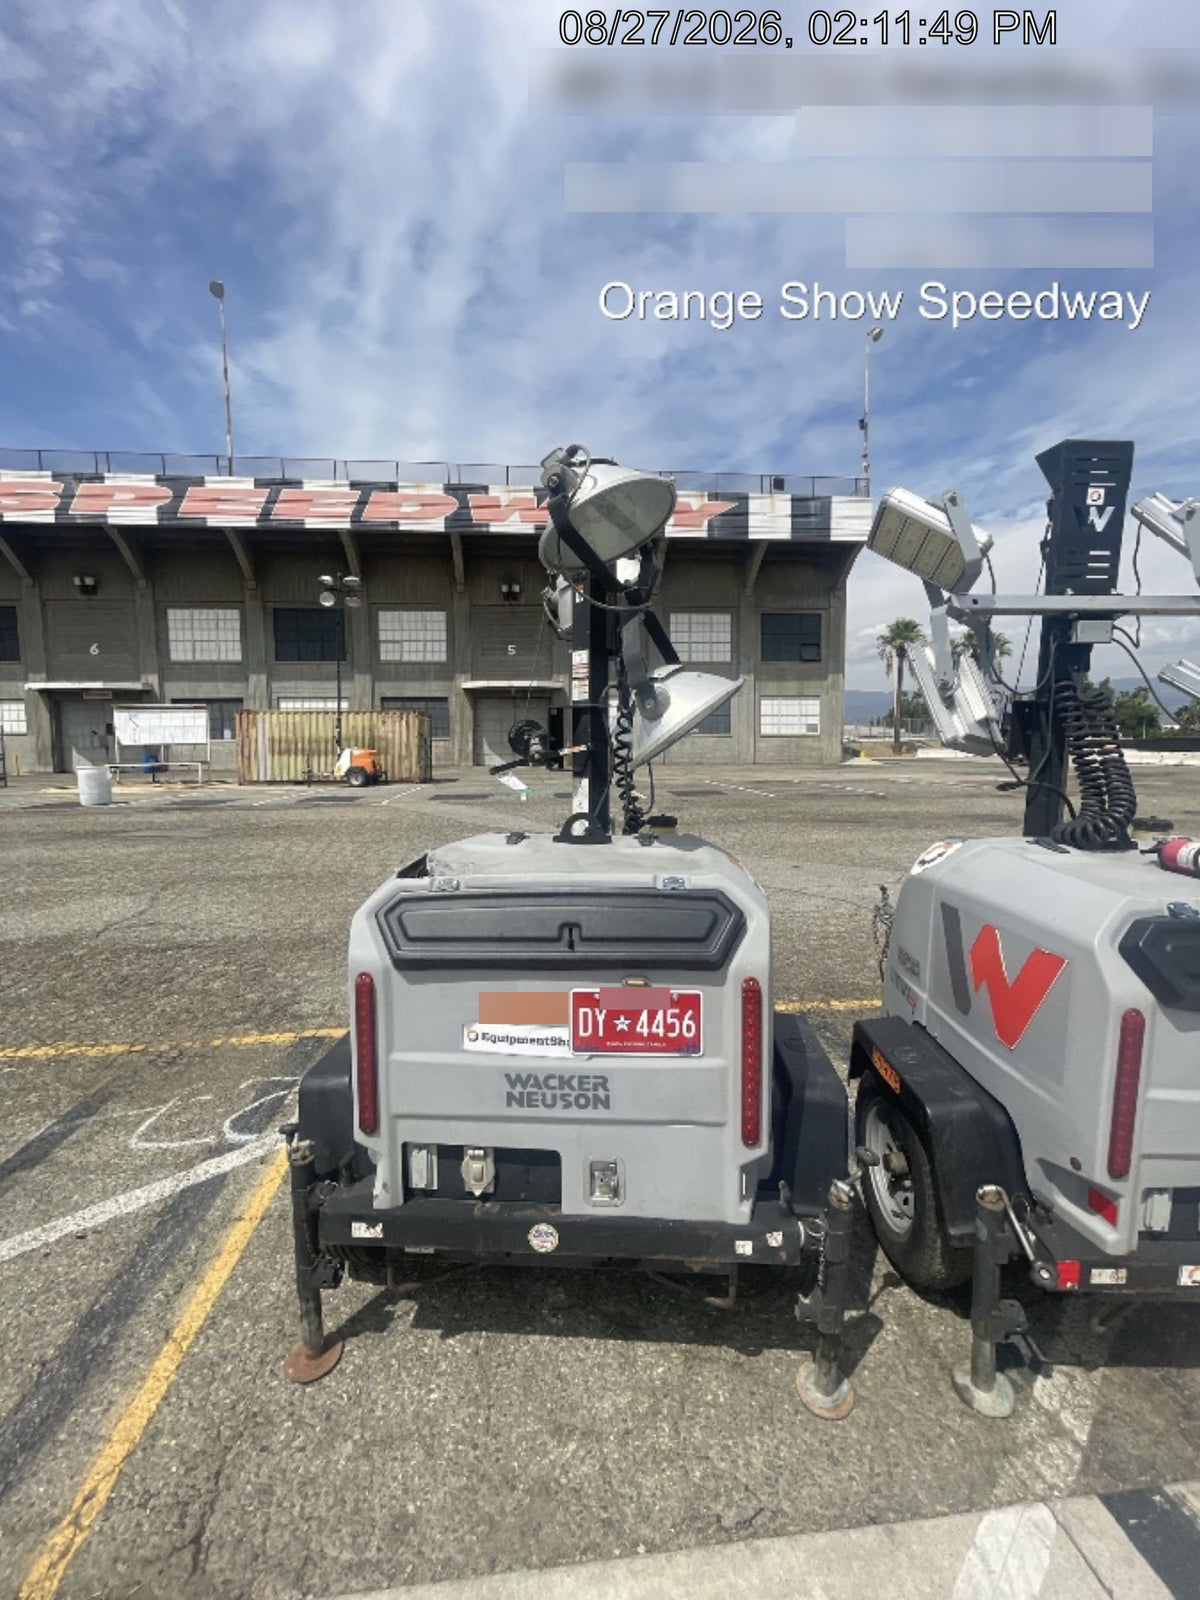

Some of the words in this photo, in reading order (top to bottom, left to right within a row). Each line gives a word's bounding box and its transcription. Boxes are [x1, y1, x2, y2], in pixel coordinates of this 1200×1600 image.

[0, 480, 738, 528] SPEEDWY
[89, 643, 100, 655] 6
[507, 645, 516, 655] 5
[578, 1007, 607, 1038] DY
[635, 1007, 696, 1038] 4456
[505, 1073, 610, 1091] WACKER
[506, 1091, 610, 1110] NEUSON
